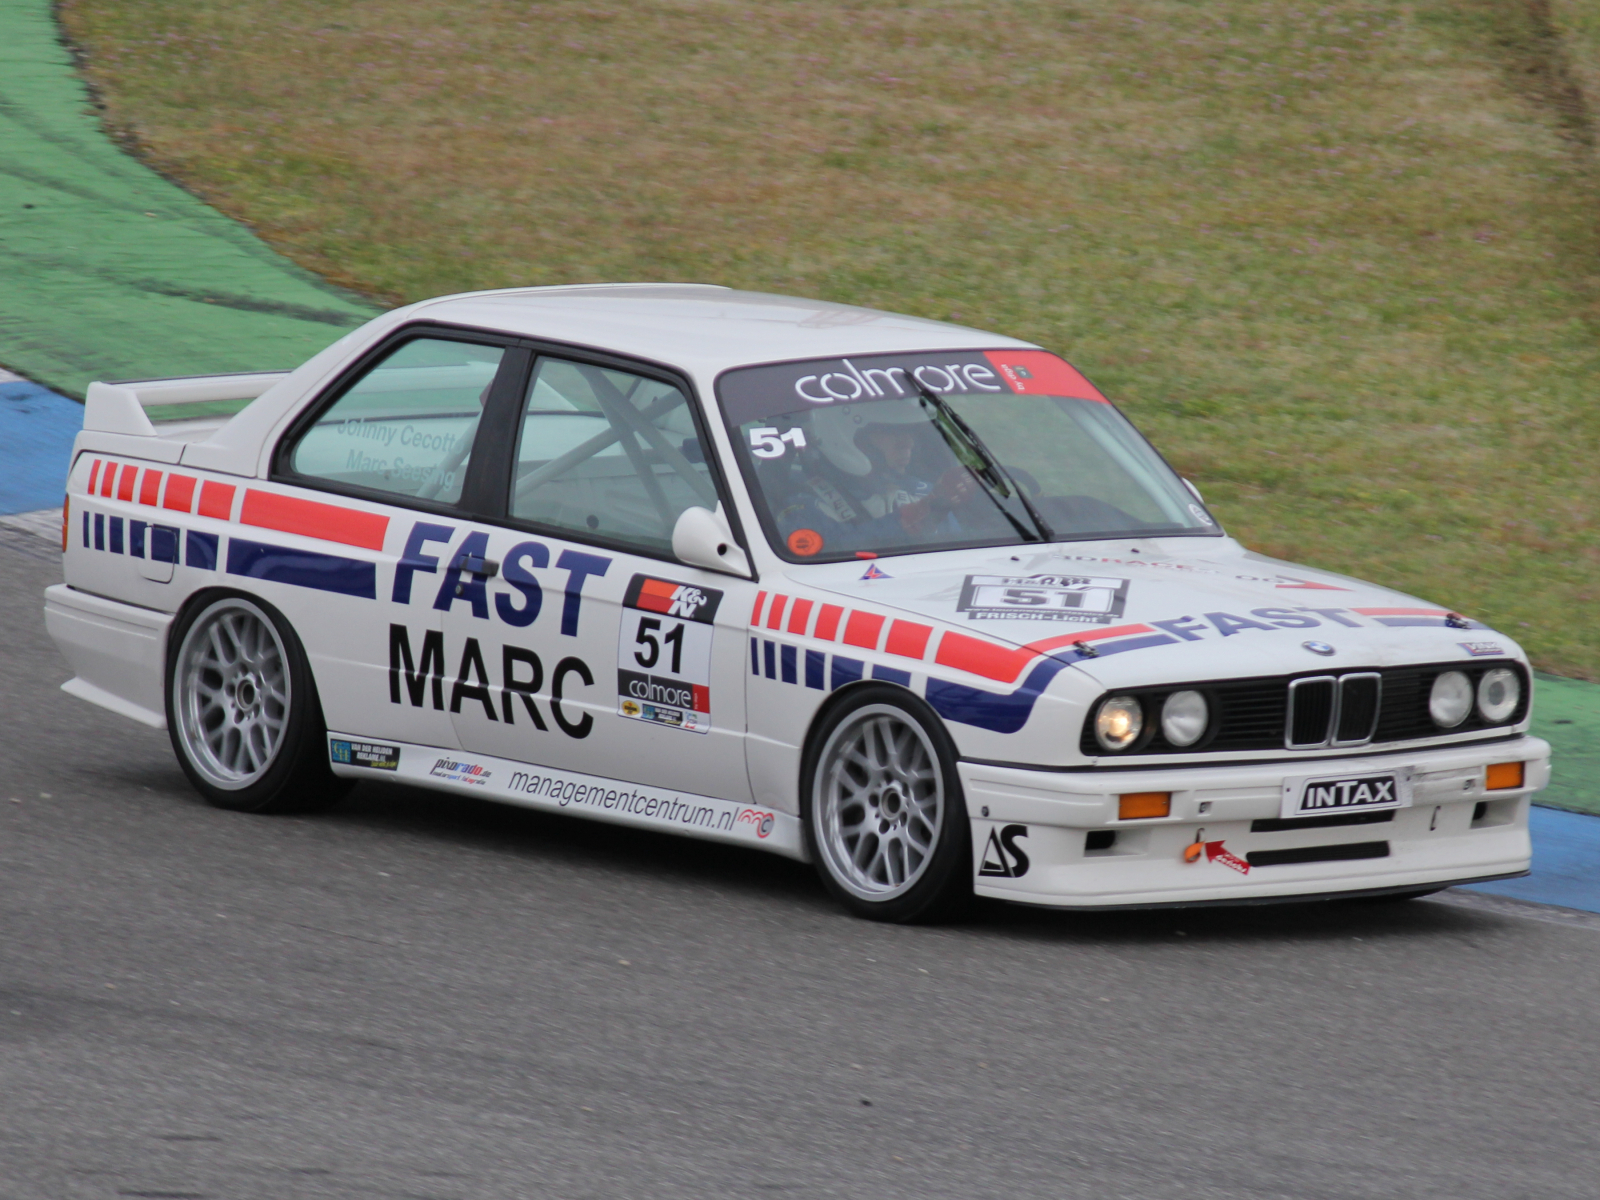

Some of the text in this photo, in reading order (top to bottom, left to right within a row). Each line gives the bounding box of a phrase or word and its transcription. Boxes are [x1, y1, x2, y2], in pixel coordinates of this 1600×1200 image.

[795, 358, 1001, 403] colmore
[337, 417, 397, 447] Johnny
[749, 427, 807, 458] 51
[346, 449, 388, 475] Marc
[392, 521, 613, 637] FAST
[1000, 588, 1087, 608] 51
[976, 612, 1099, 624] FRISCH-Licht
[1149, 606, 1365, 642] FAST
[634, 616, 685, 674] 51
[389, 623, 595, 739] MARC
[629, 674, 692, 708] colmore
[430, 757, 492, 778] pixorado.de
[508, 770, 740, 831] managementcentrum.nl
[1306, 780, 1394, 808] INTAX
